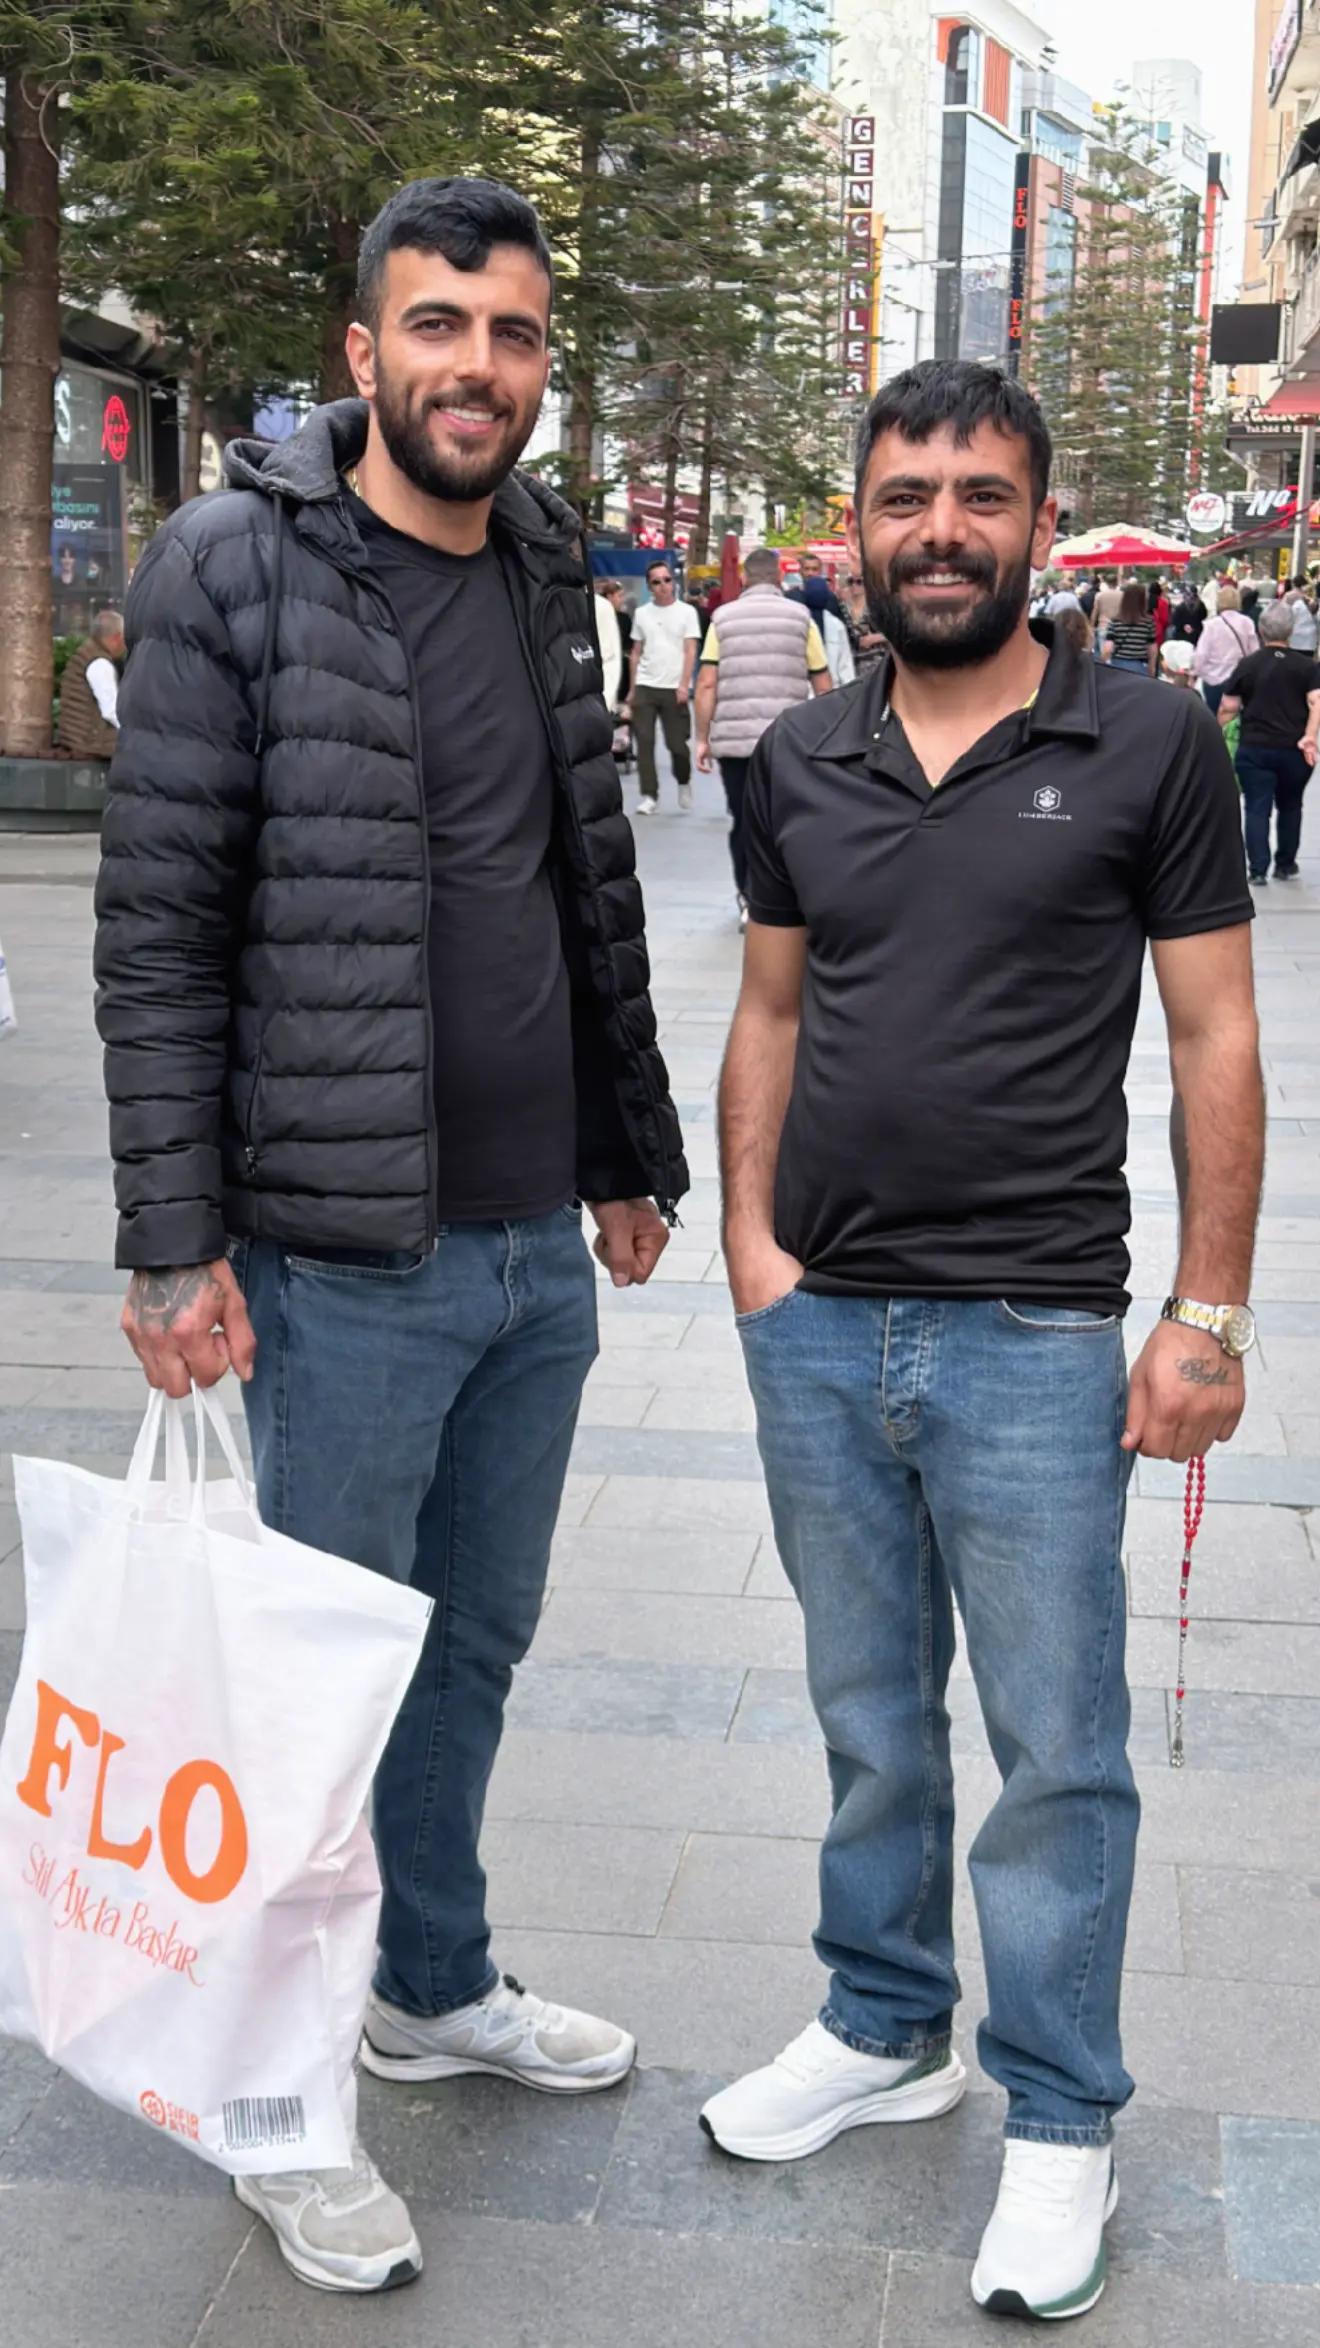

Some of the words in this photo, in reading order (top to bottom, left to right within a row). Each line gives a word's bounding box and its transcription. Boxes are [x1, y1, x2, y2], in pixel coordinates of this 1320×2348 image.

[1014, 187, 1029, 229] FLO
[1009, 299, 1023, 338] FLO
[16, 1679, 249, 1904] FLO
